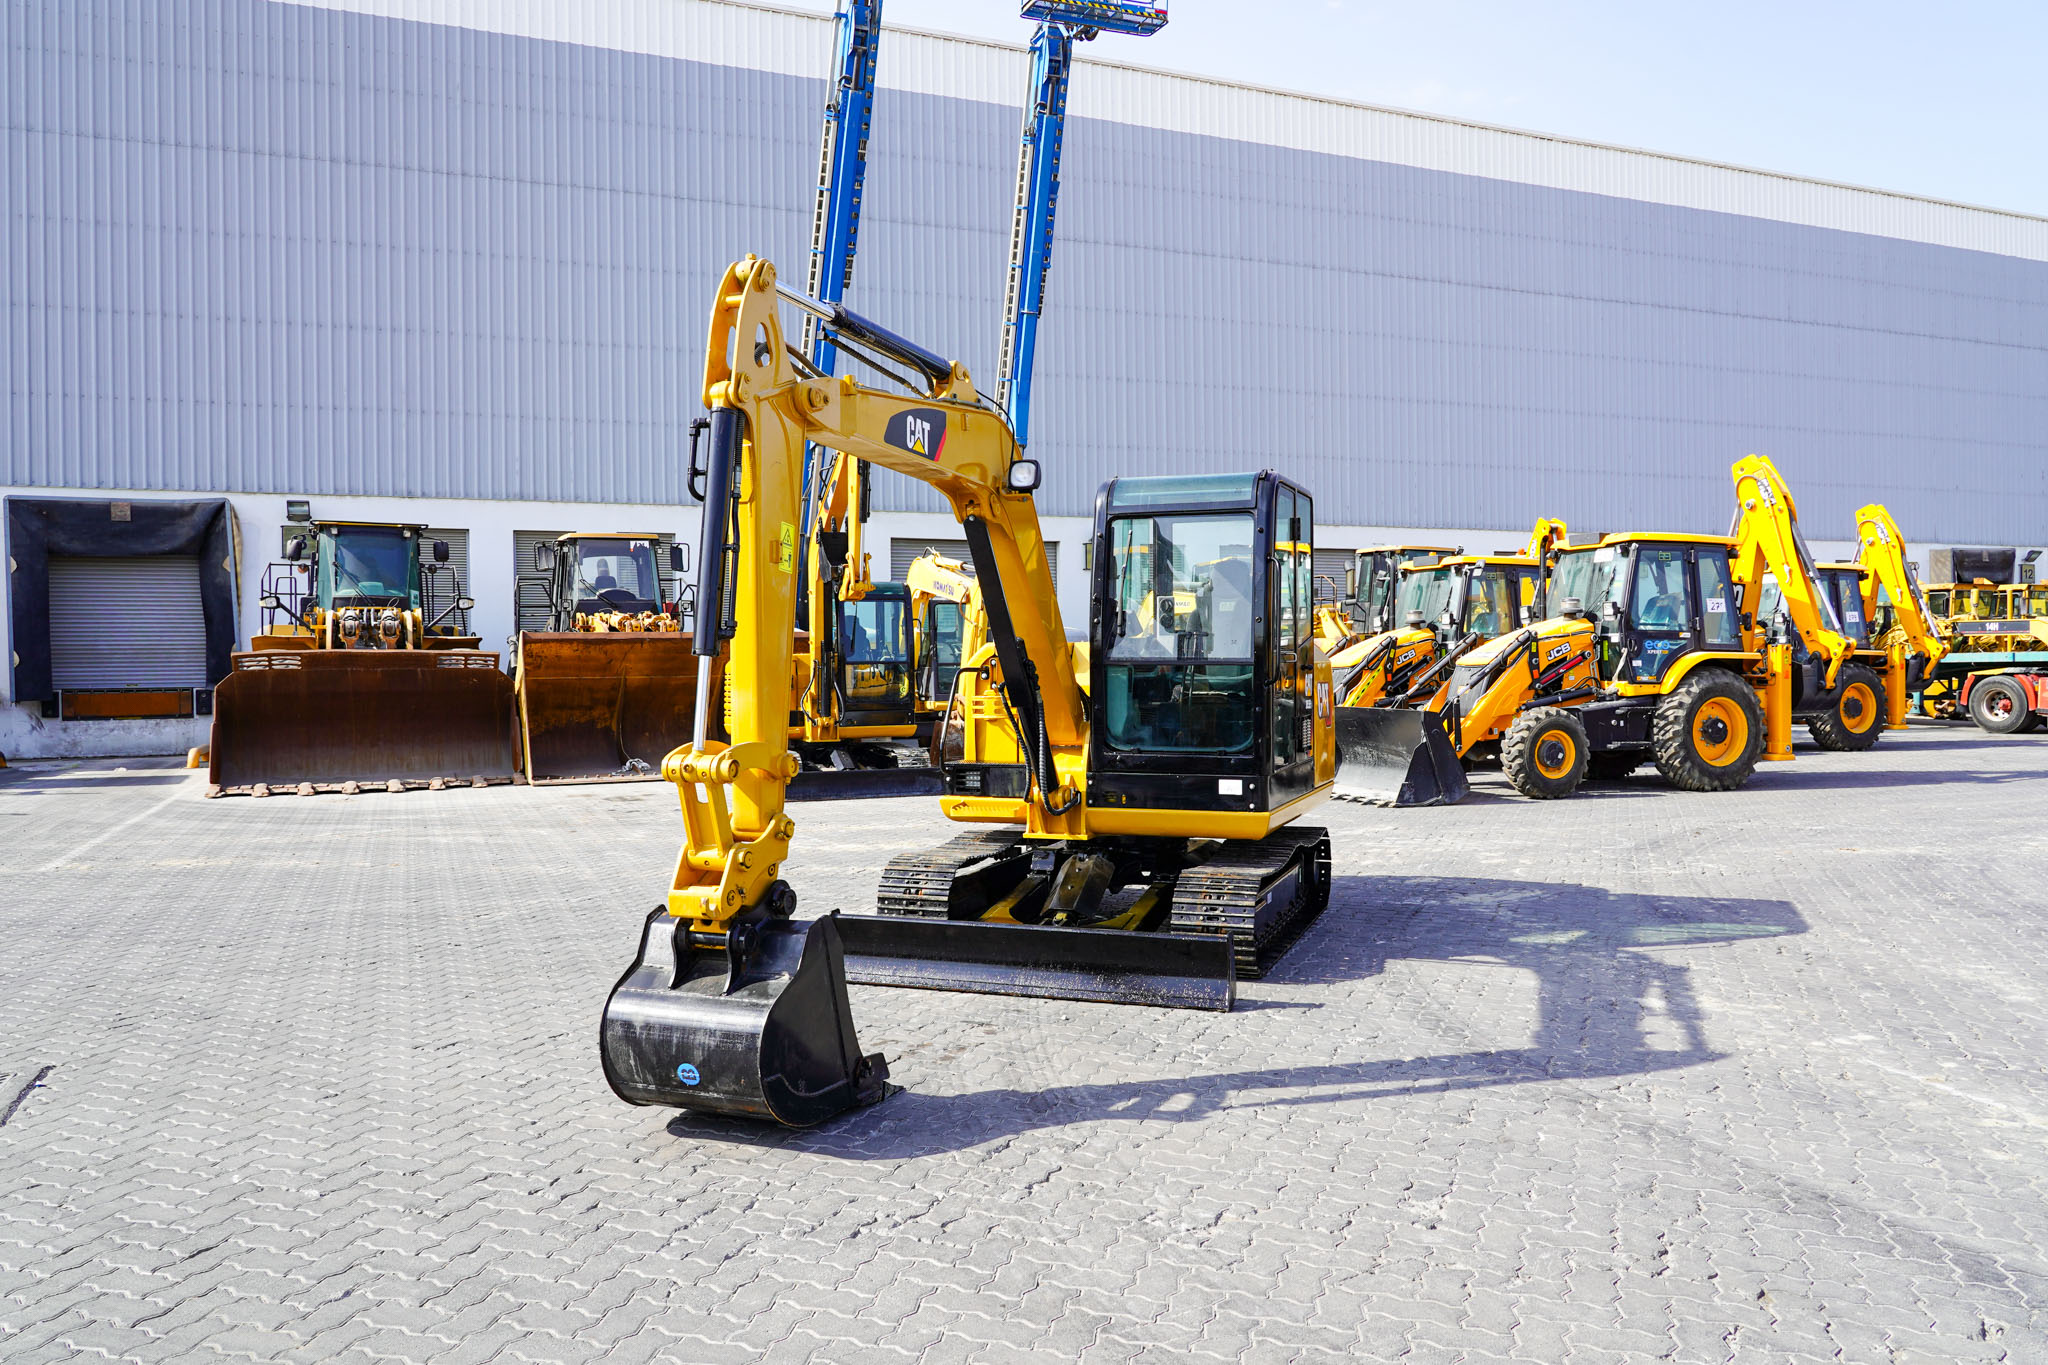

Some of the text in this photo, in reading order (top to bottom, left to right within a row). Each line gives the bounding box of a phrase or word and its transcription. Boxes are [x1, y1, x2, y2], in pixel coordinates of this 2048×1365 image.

[906, 415, 931, 456] CAT
[2023, 568, 2033, 580] 12
[1985, 622, 1999, 631] 14H
[1547, 642, 1571, 661] JCB
[1644, 640, 1670, 650] eco
[1397, 649, 1416, 665] JCB
[1317, 682, 1330, 718] CAT
